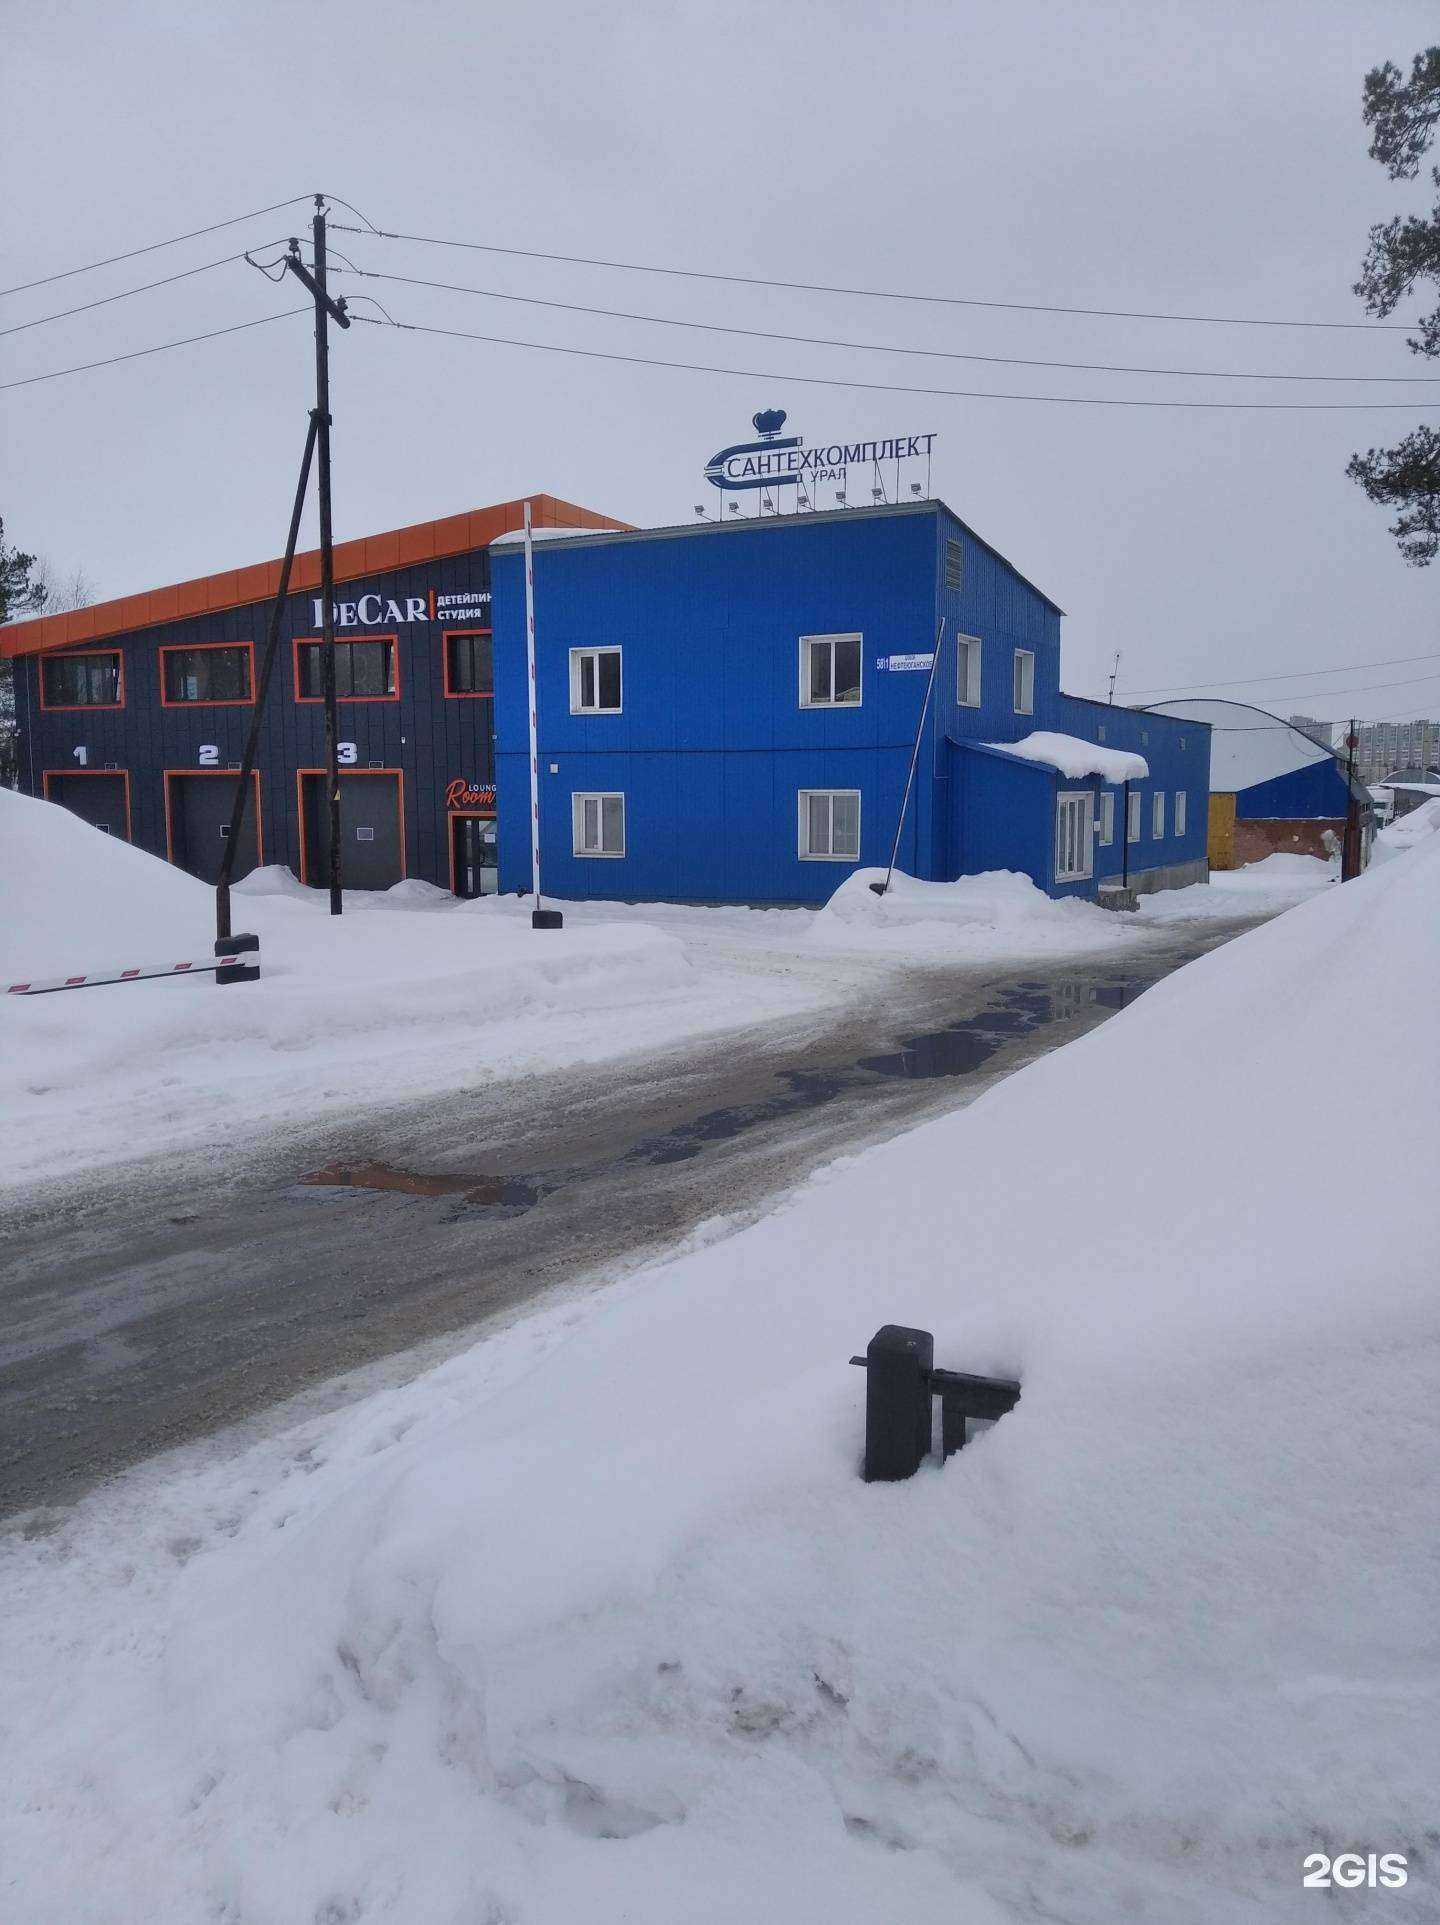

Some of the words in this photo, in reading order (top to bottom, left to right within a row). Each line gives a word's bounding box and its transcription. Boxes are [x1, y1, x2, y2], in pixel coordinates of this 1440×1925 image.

[727, 433, 938, 478] САНТЕХКОМПЛЕКТ
[810, 467, 848, 483] УРАЛ
[437, 608, 482, 620] СТУДИЯ
[72, 746, 88, 765] 1
[198, 744, 219, 765] 2
[337, 742, 358, 764] 3
[446, 779, 496, 808] Room
